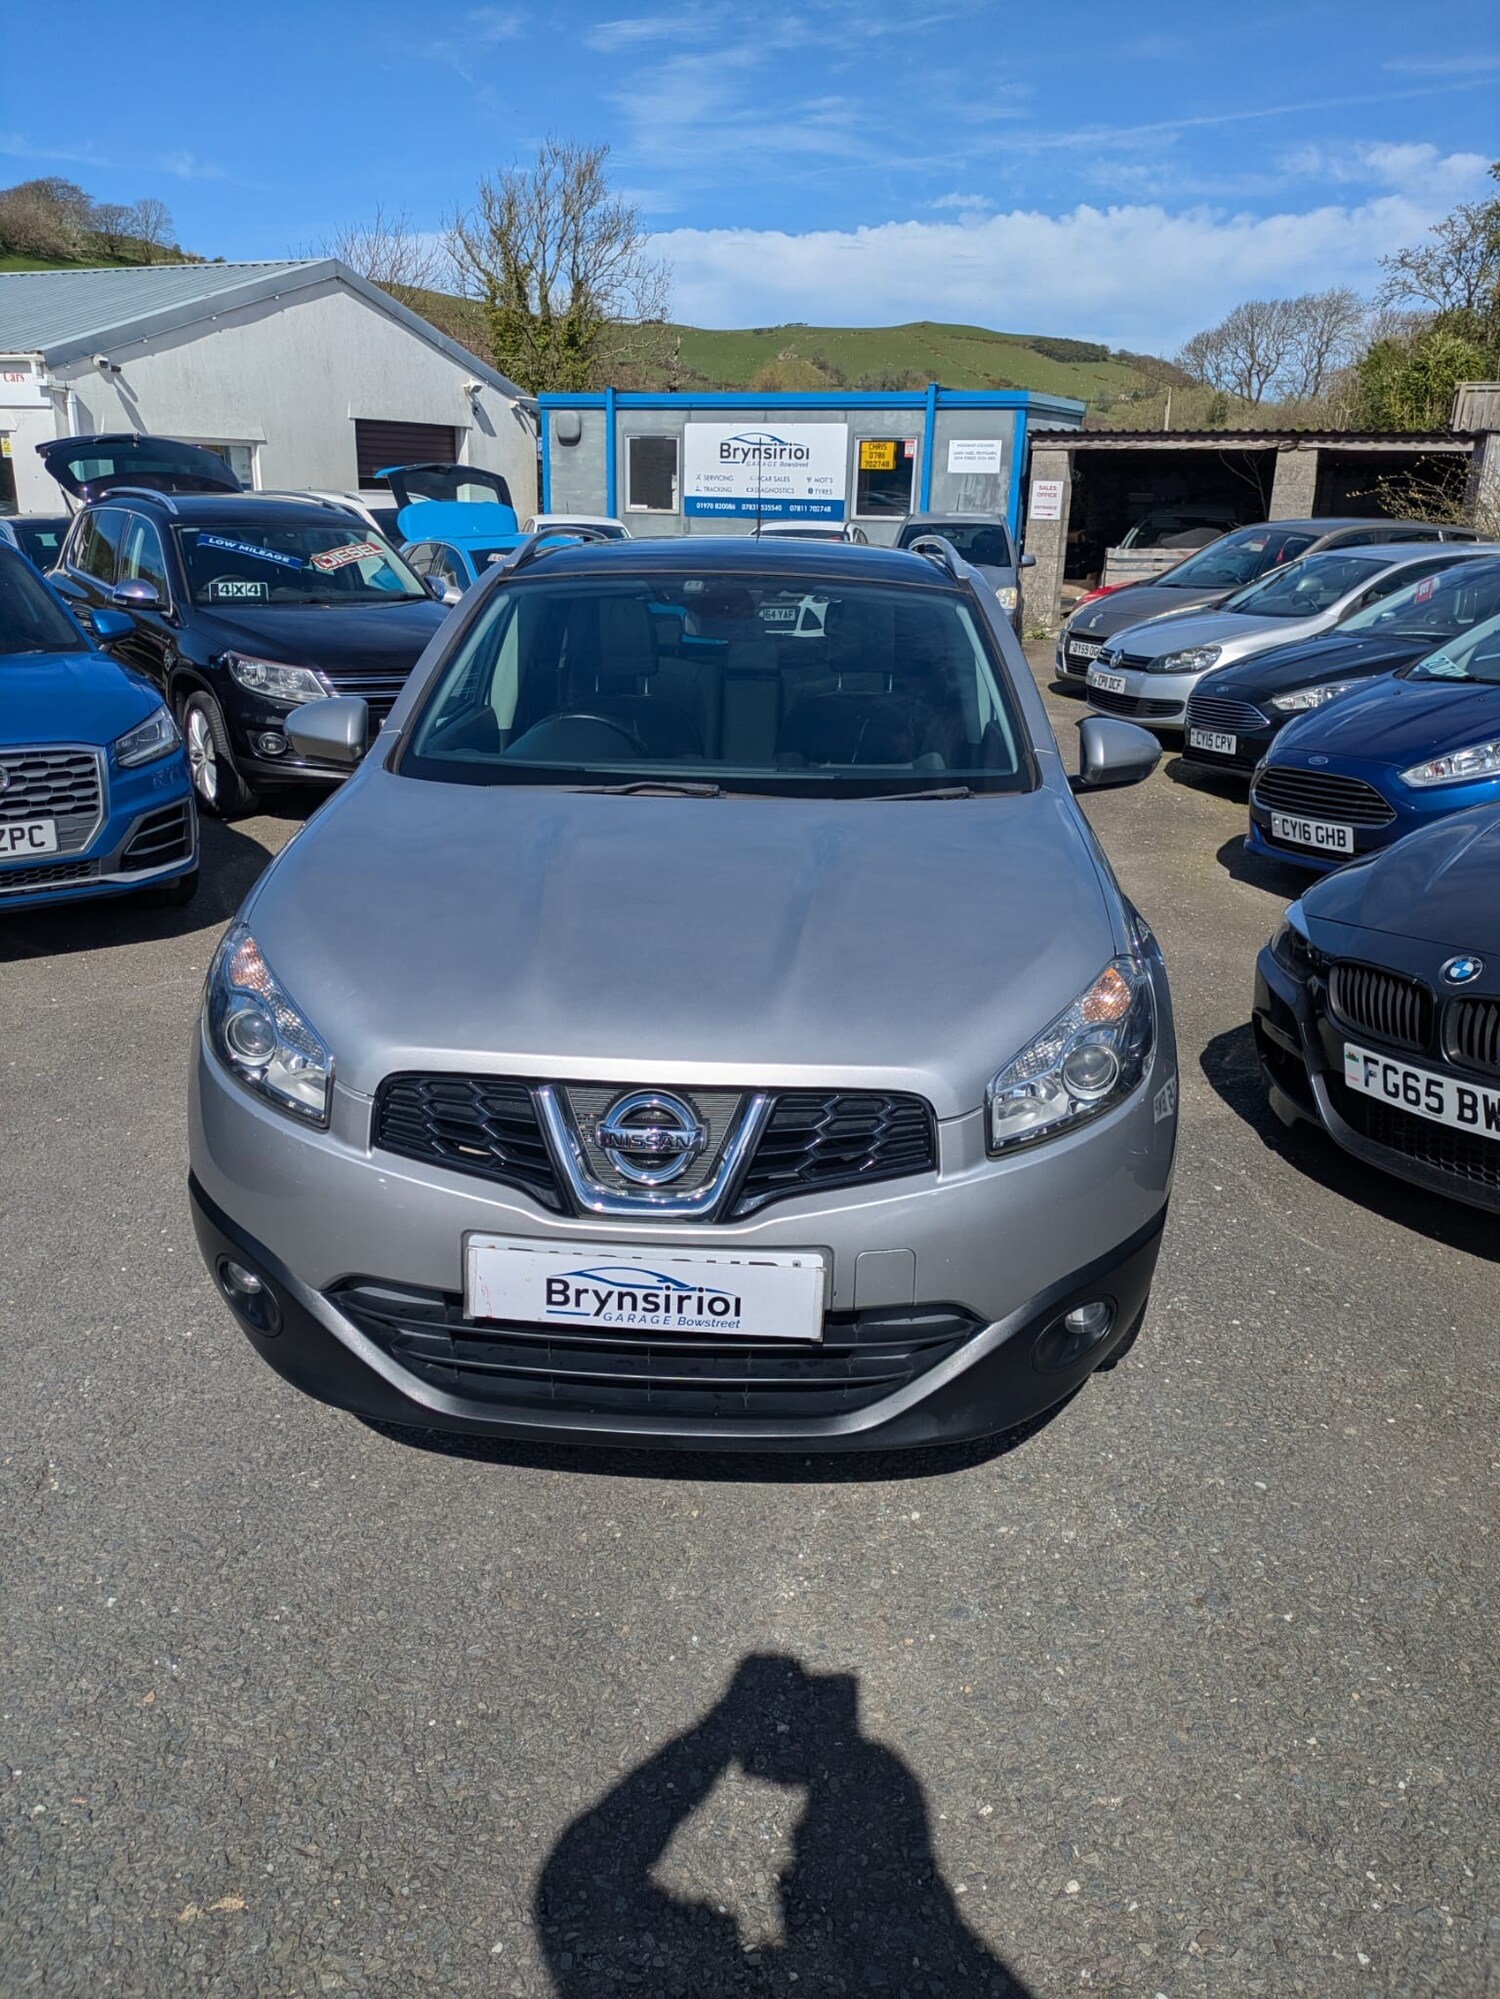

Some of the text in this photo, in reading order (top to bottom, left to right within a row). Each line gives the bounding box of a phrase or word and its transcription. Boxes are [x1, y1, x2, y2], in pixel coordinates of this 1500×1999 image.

[3, 371, 25, 383] Cars
[720, 442, 810, 464] Brynsiriol
[868, 443, 888, 451] CHRIS
[703, 474, 734, 482] SERVICING
[760, 475, 791, 483] CAR SALES
[696, 502, 714, 510] 01970
[208, 537, 291, 563] LOW MILEAGE
[316, 543, 385, 569] DIESEL
[1196, 731, 1233, 750] CY15 CPV
[1281, 818, 1347, 848] CY16 GHB
[1363, 1055, 1500, 1133] FG65 BW
[606, 1132, 692, 1151] NISSAN
[546, 1278, 742, 1318] Brynsiriol
[603, 1312, 741, 1329] GARAGE Bowstreet
